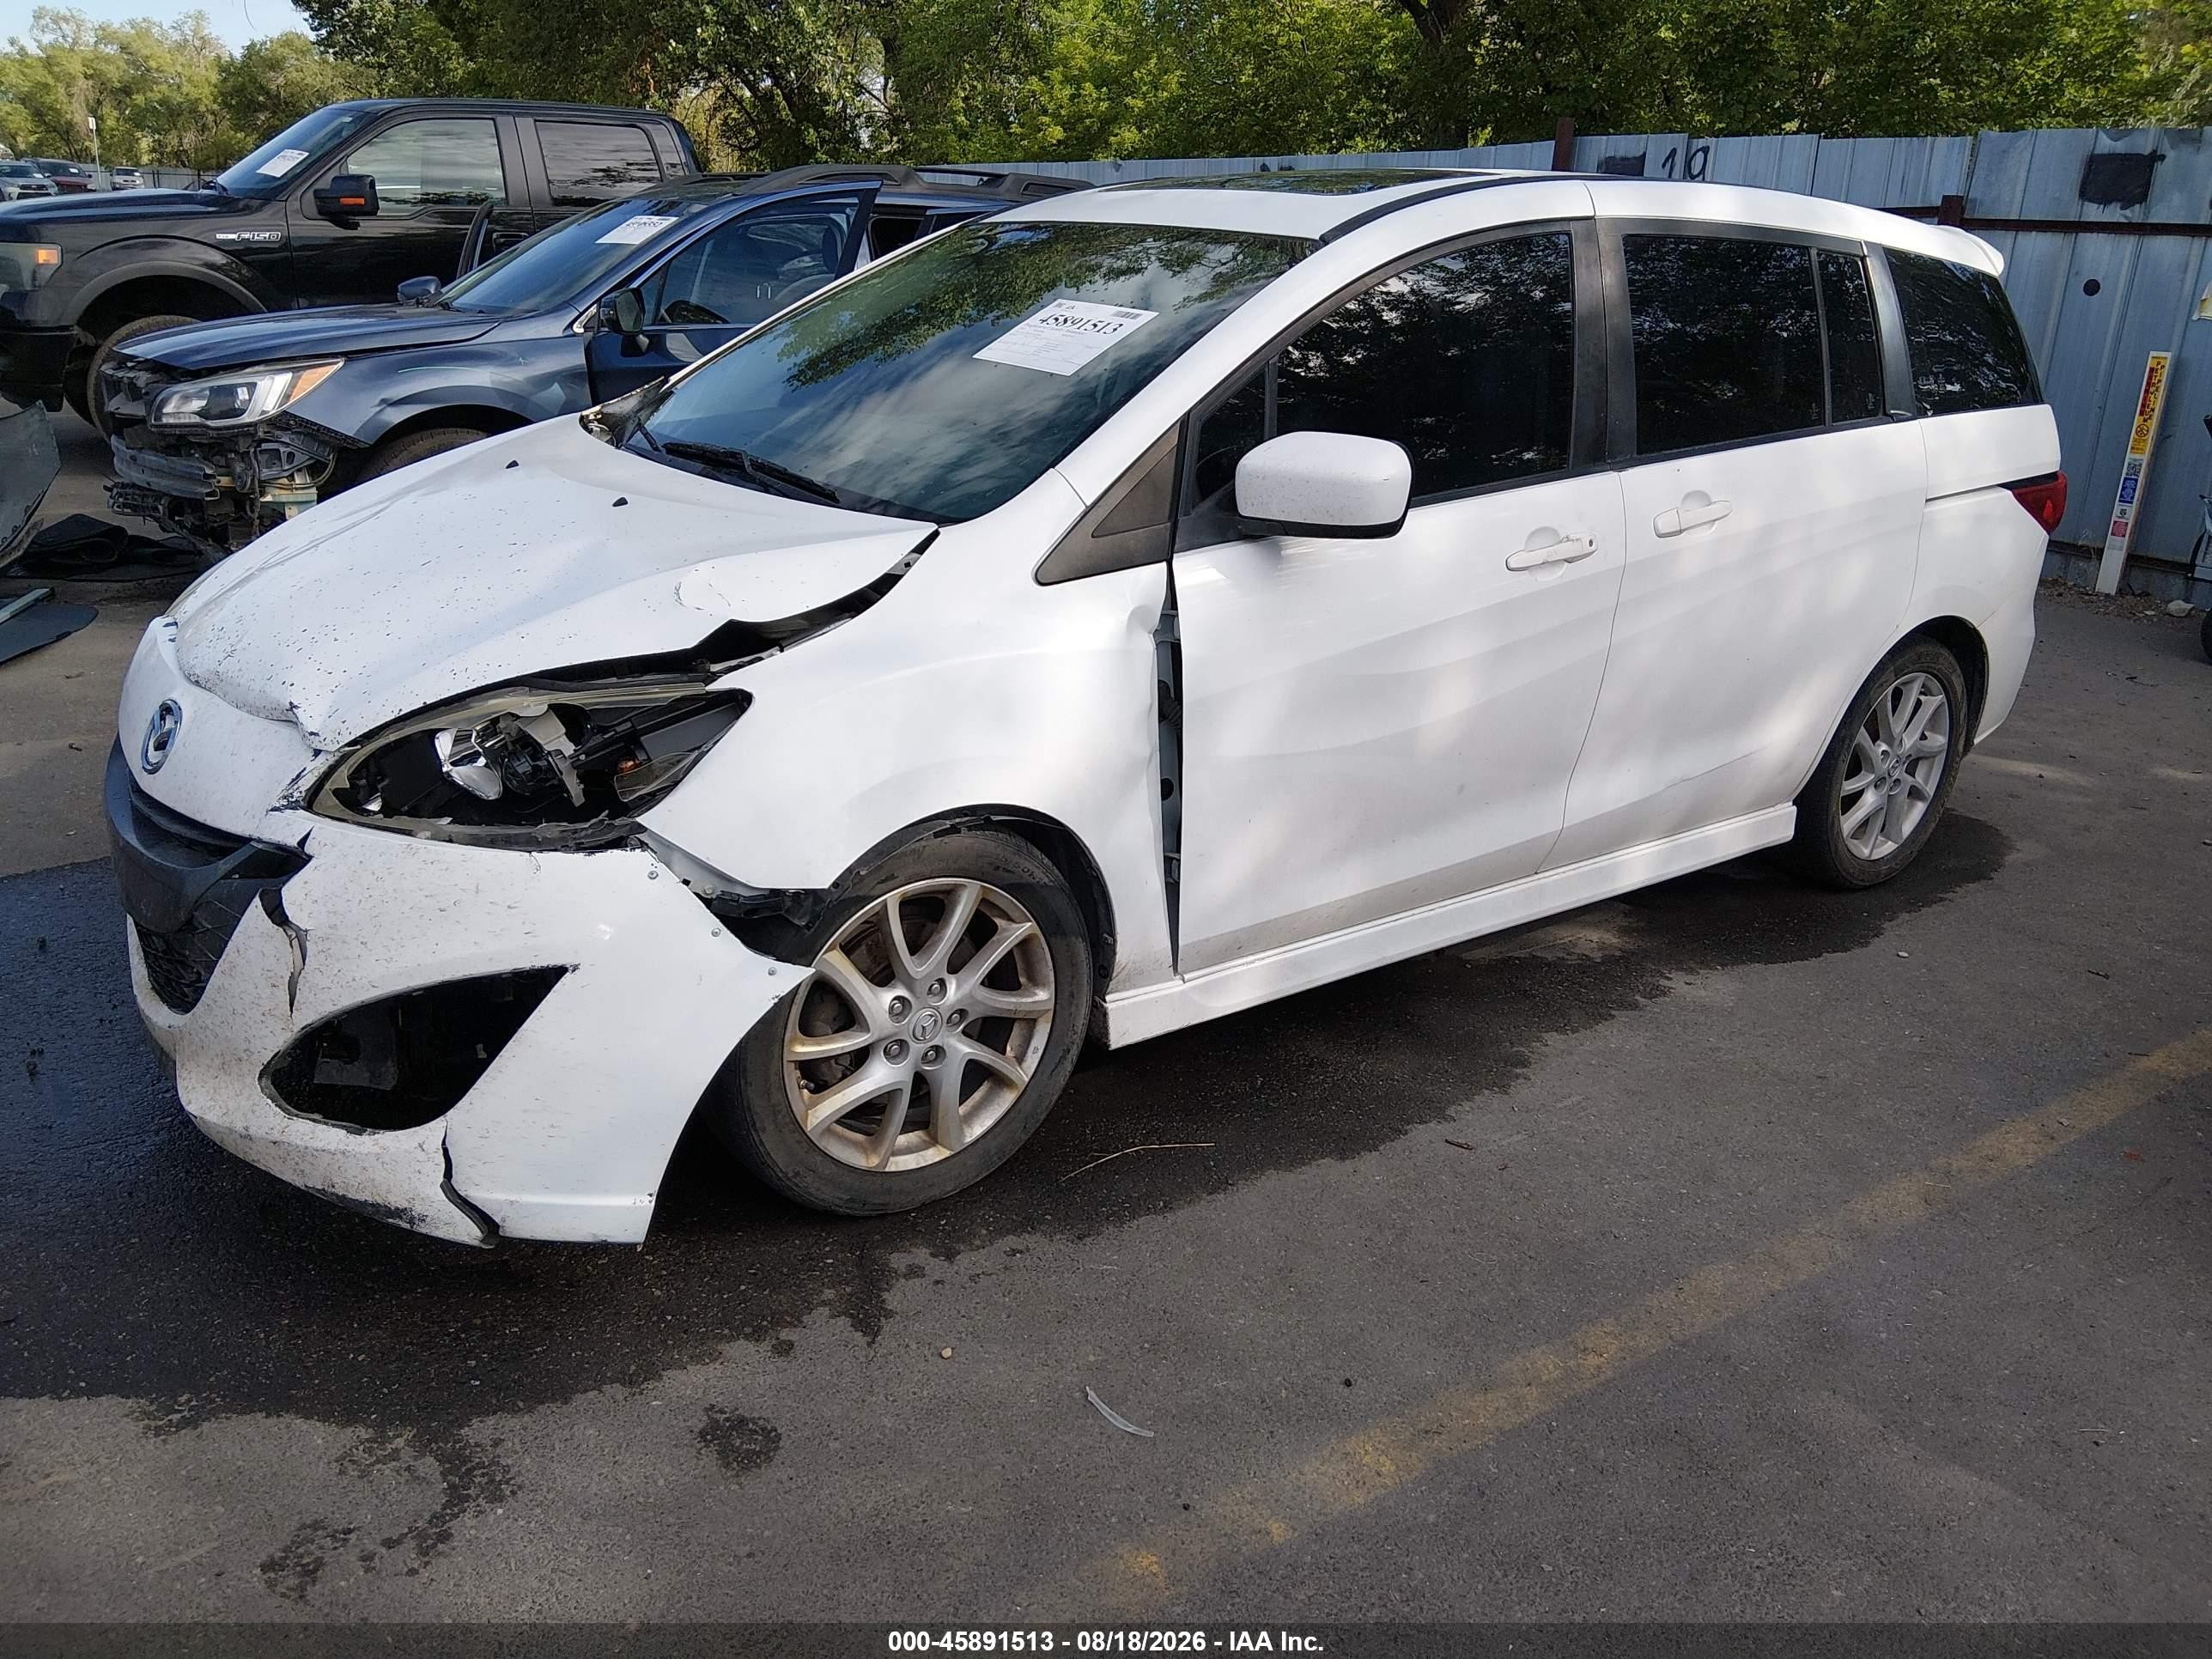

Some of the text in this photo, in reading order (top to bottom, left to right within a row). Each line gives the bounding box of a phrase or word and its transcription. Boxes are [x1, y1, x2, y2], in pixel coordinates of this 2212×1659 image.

[235, 231, 282, 241] F-150
[1038, 313, 1124, 335] 45891513
[2142, 360, 2161, 422] PETROLEUM
[2148, 364, 2166, 421] PIPELINE
